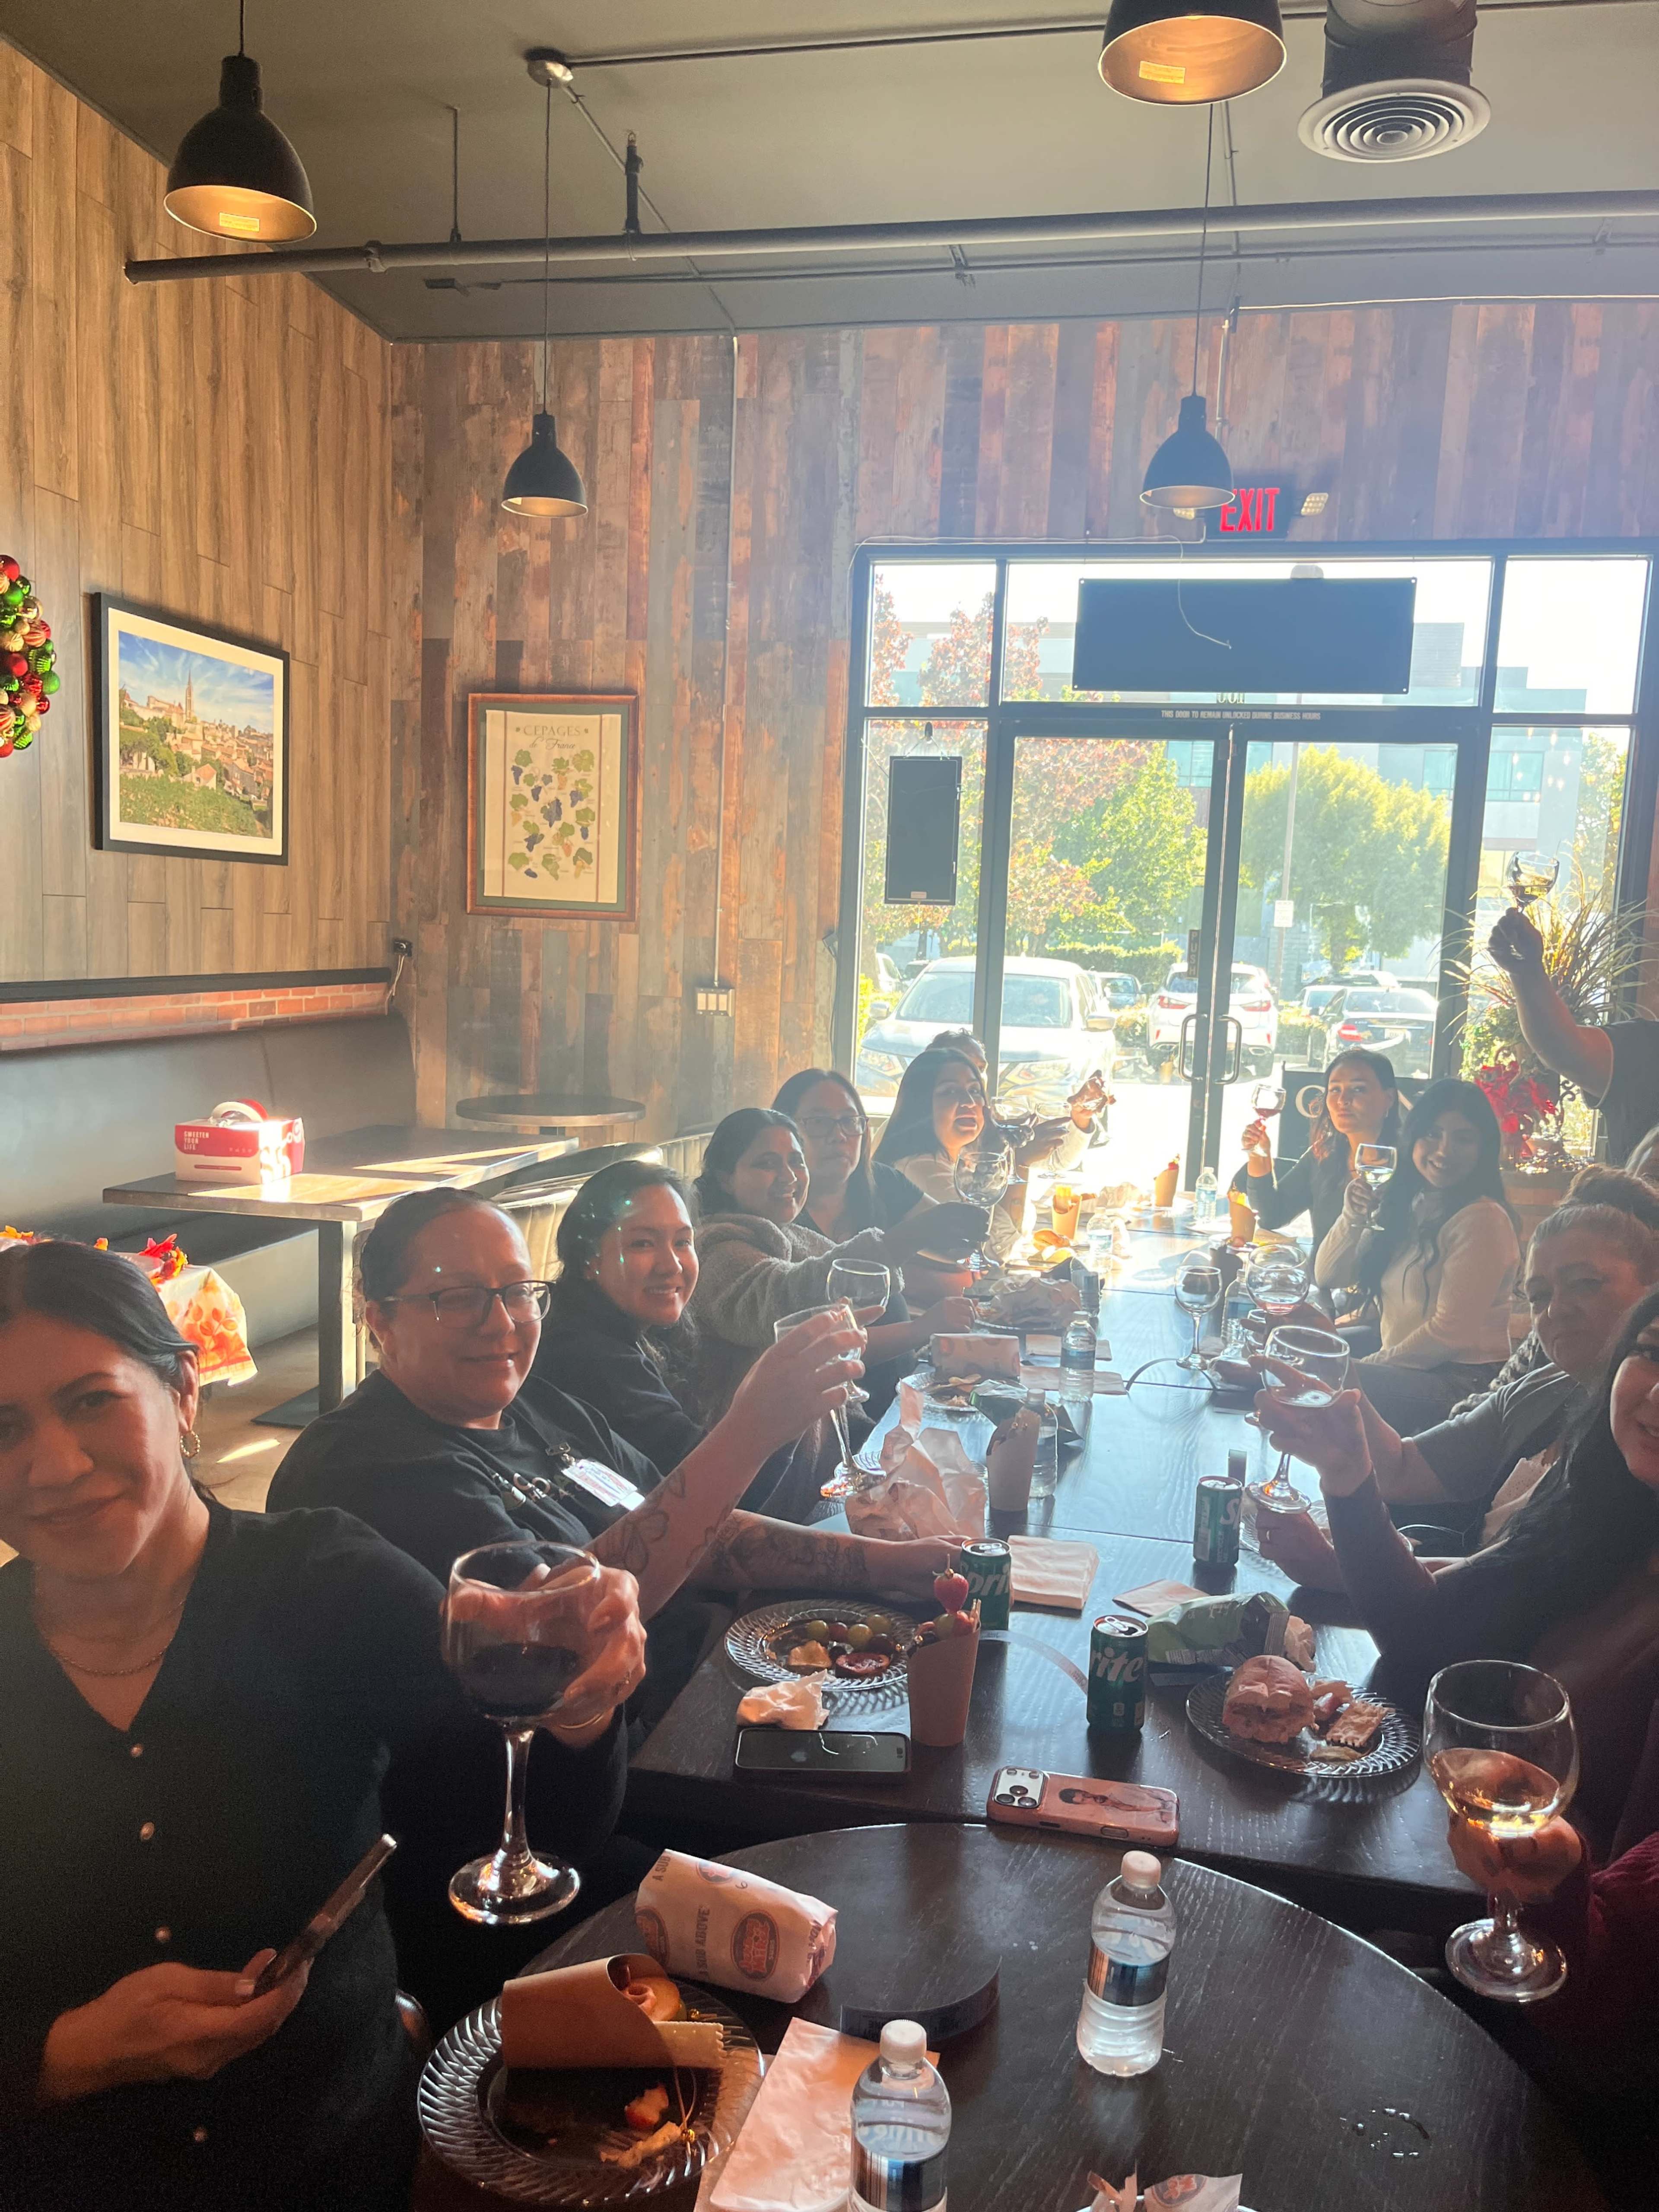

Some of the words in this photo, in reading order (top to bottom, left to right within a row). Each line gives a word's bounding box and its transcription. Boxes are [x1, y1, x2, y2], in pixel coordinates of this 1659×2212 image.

[1220, 487, 1280, 532] EXIT
[1222, 711, 1251, 719] UNLOCKED
[1274, 712, 1300, 720] BUSINESS
[1302, 712, 1321, 720] HOURS
[523, 725, 581, 737] CEPAGES
[529, 736, 544, 748] de
[546, 738, 576, 750] France
[1189, 931, 1198, 976] PUSH
[655, 1856, 671, 1872] SUB
[694, 1908, 710, 1947] ABOVE
[696, 1949, 708, 1970] SUB
